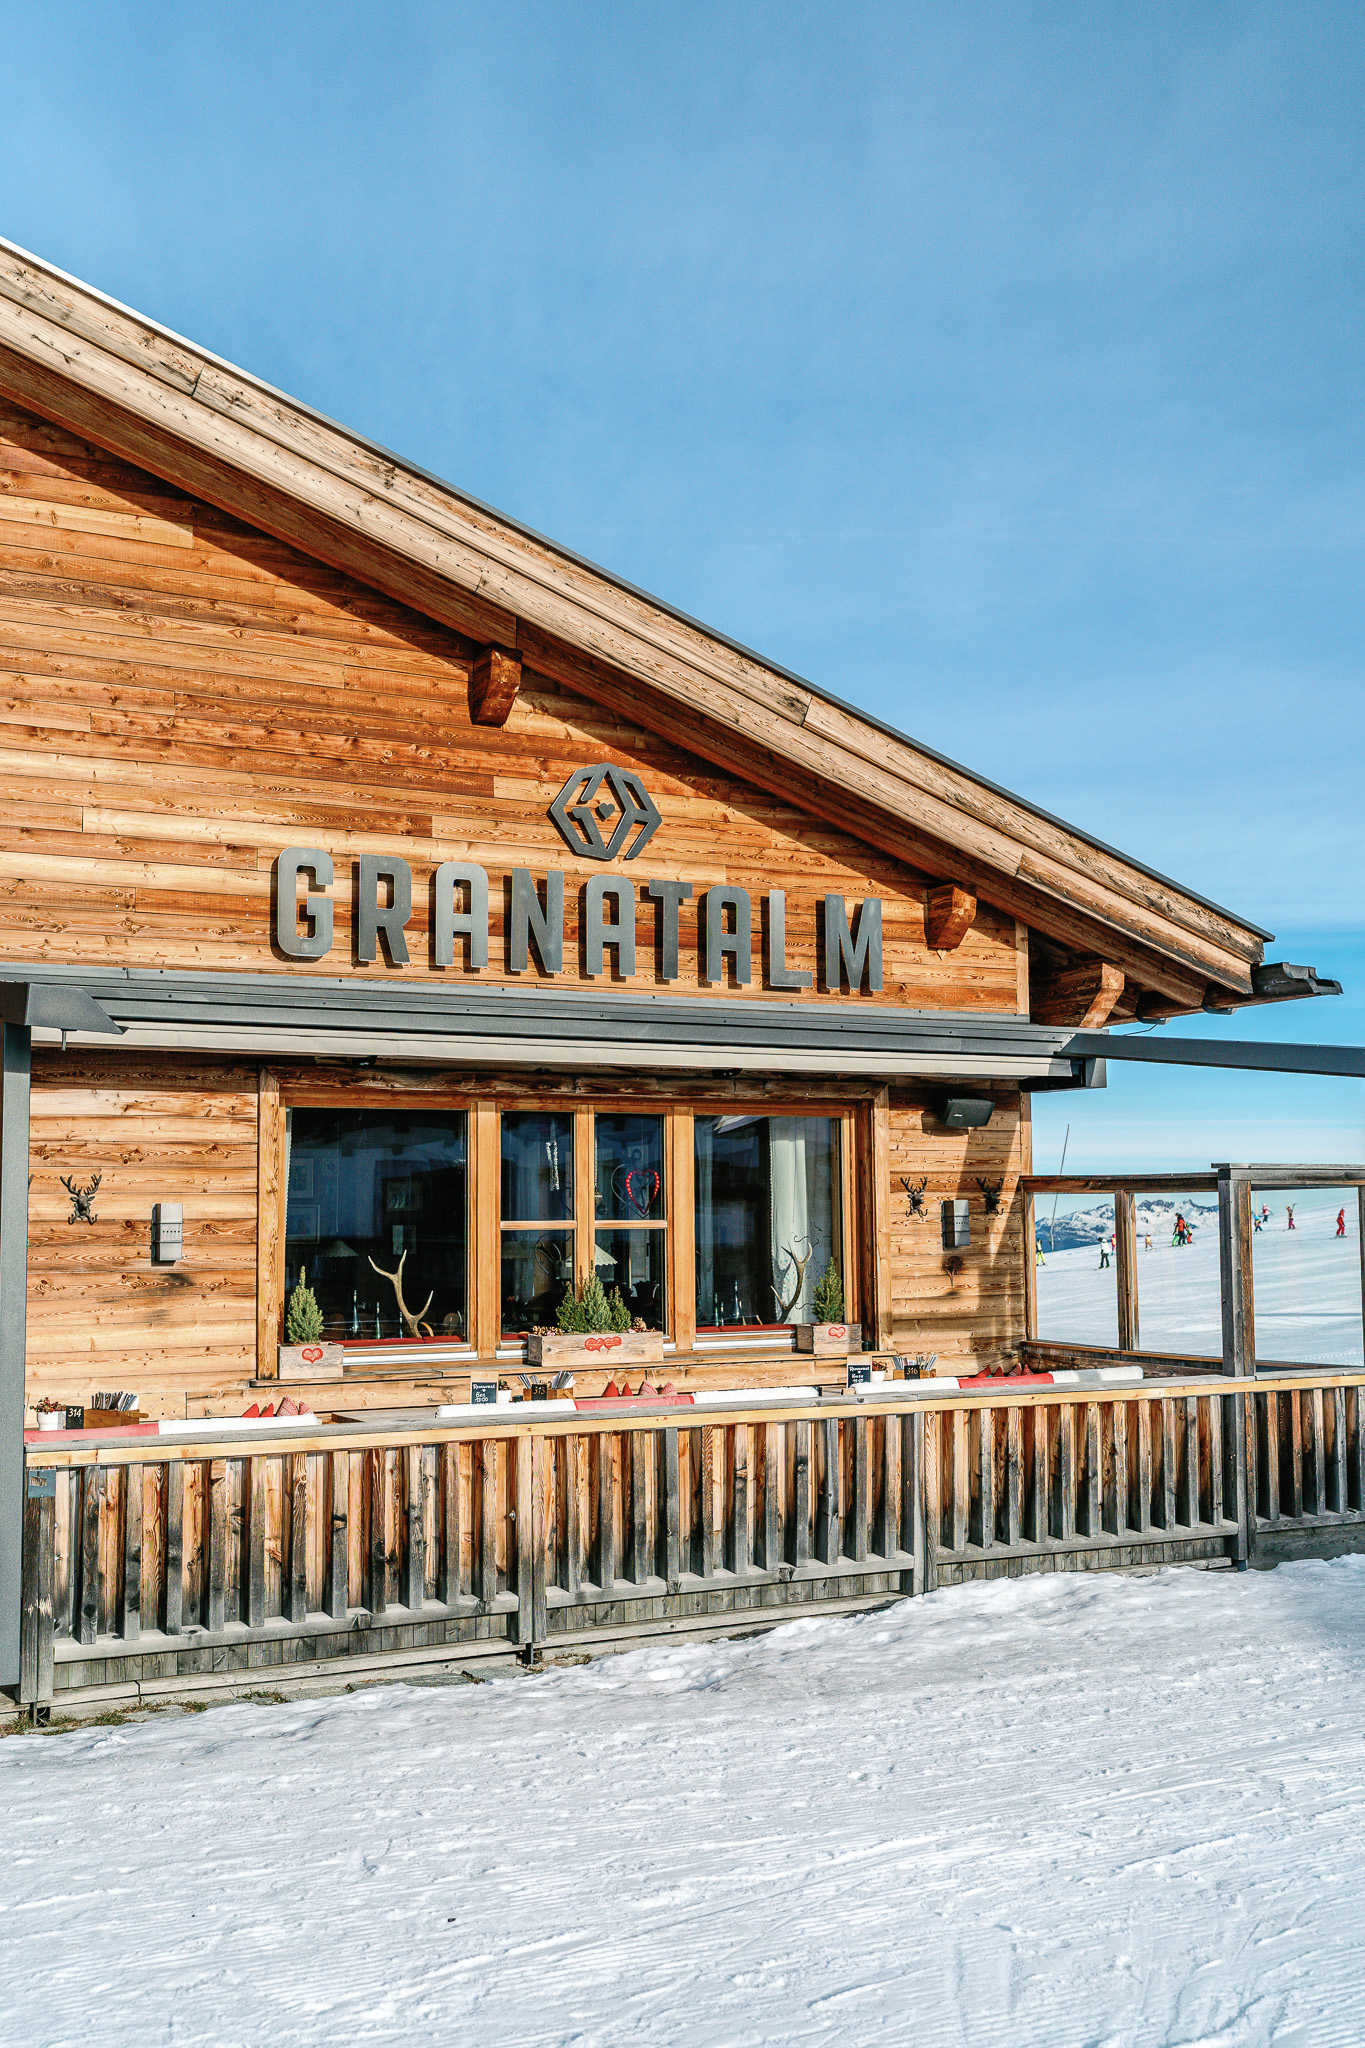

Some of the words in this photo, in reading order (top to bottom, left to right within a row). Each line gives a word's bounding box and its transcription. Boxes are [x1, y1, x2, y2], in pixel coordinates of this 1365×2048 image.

[276, 846, 883, 993] GRANATALM
[906, 1367, 919, 1375] 316
[533, 1386, 545, 1394] 315
[68, 1408, 82, 1417] 314
